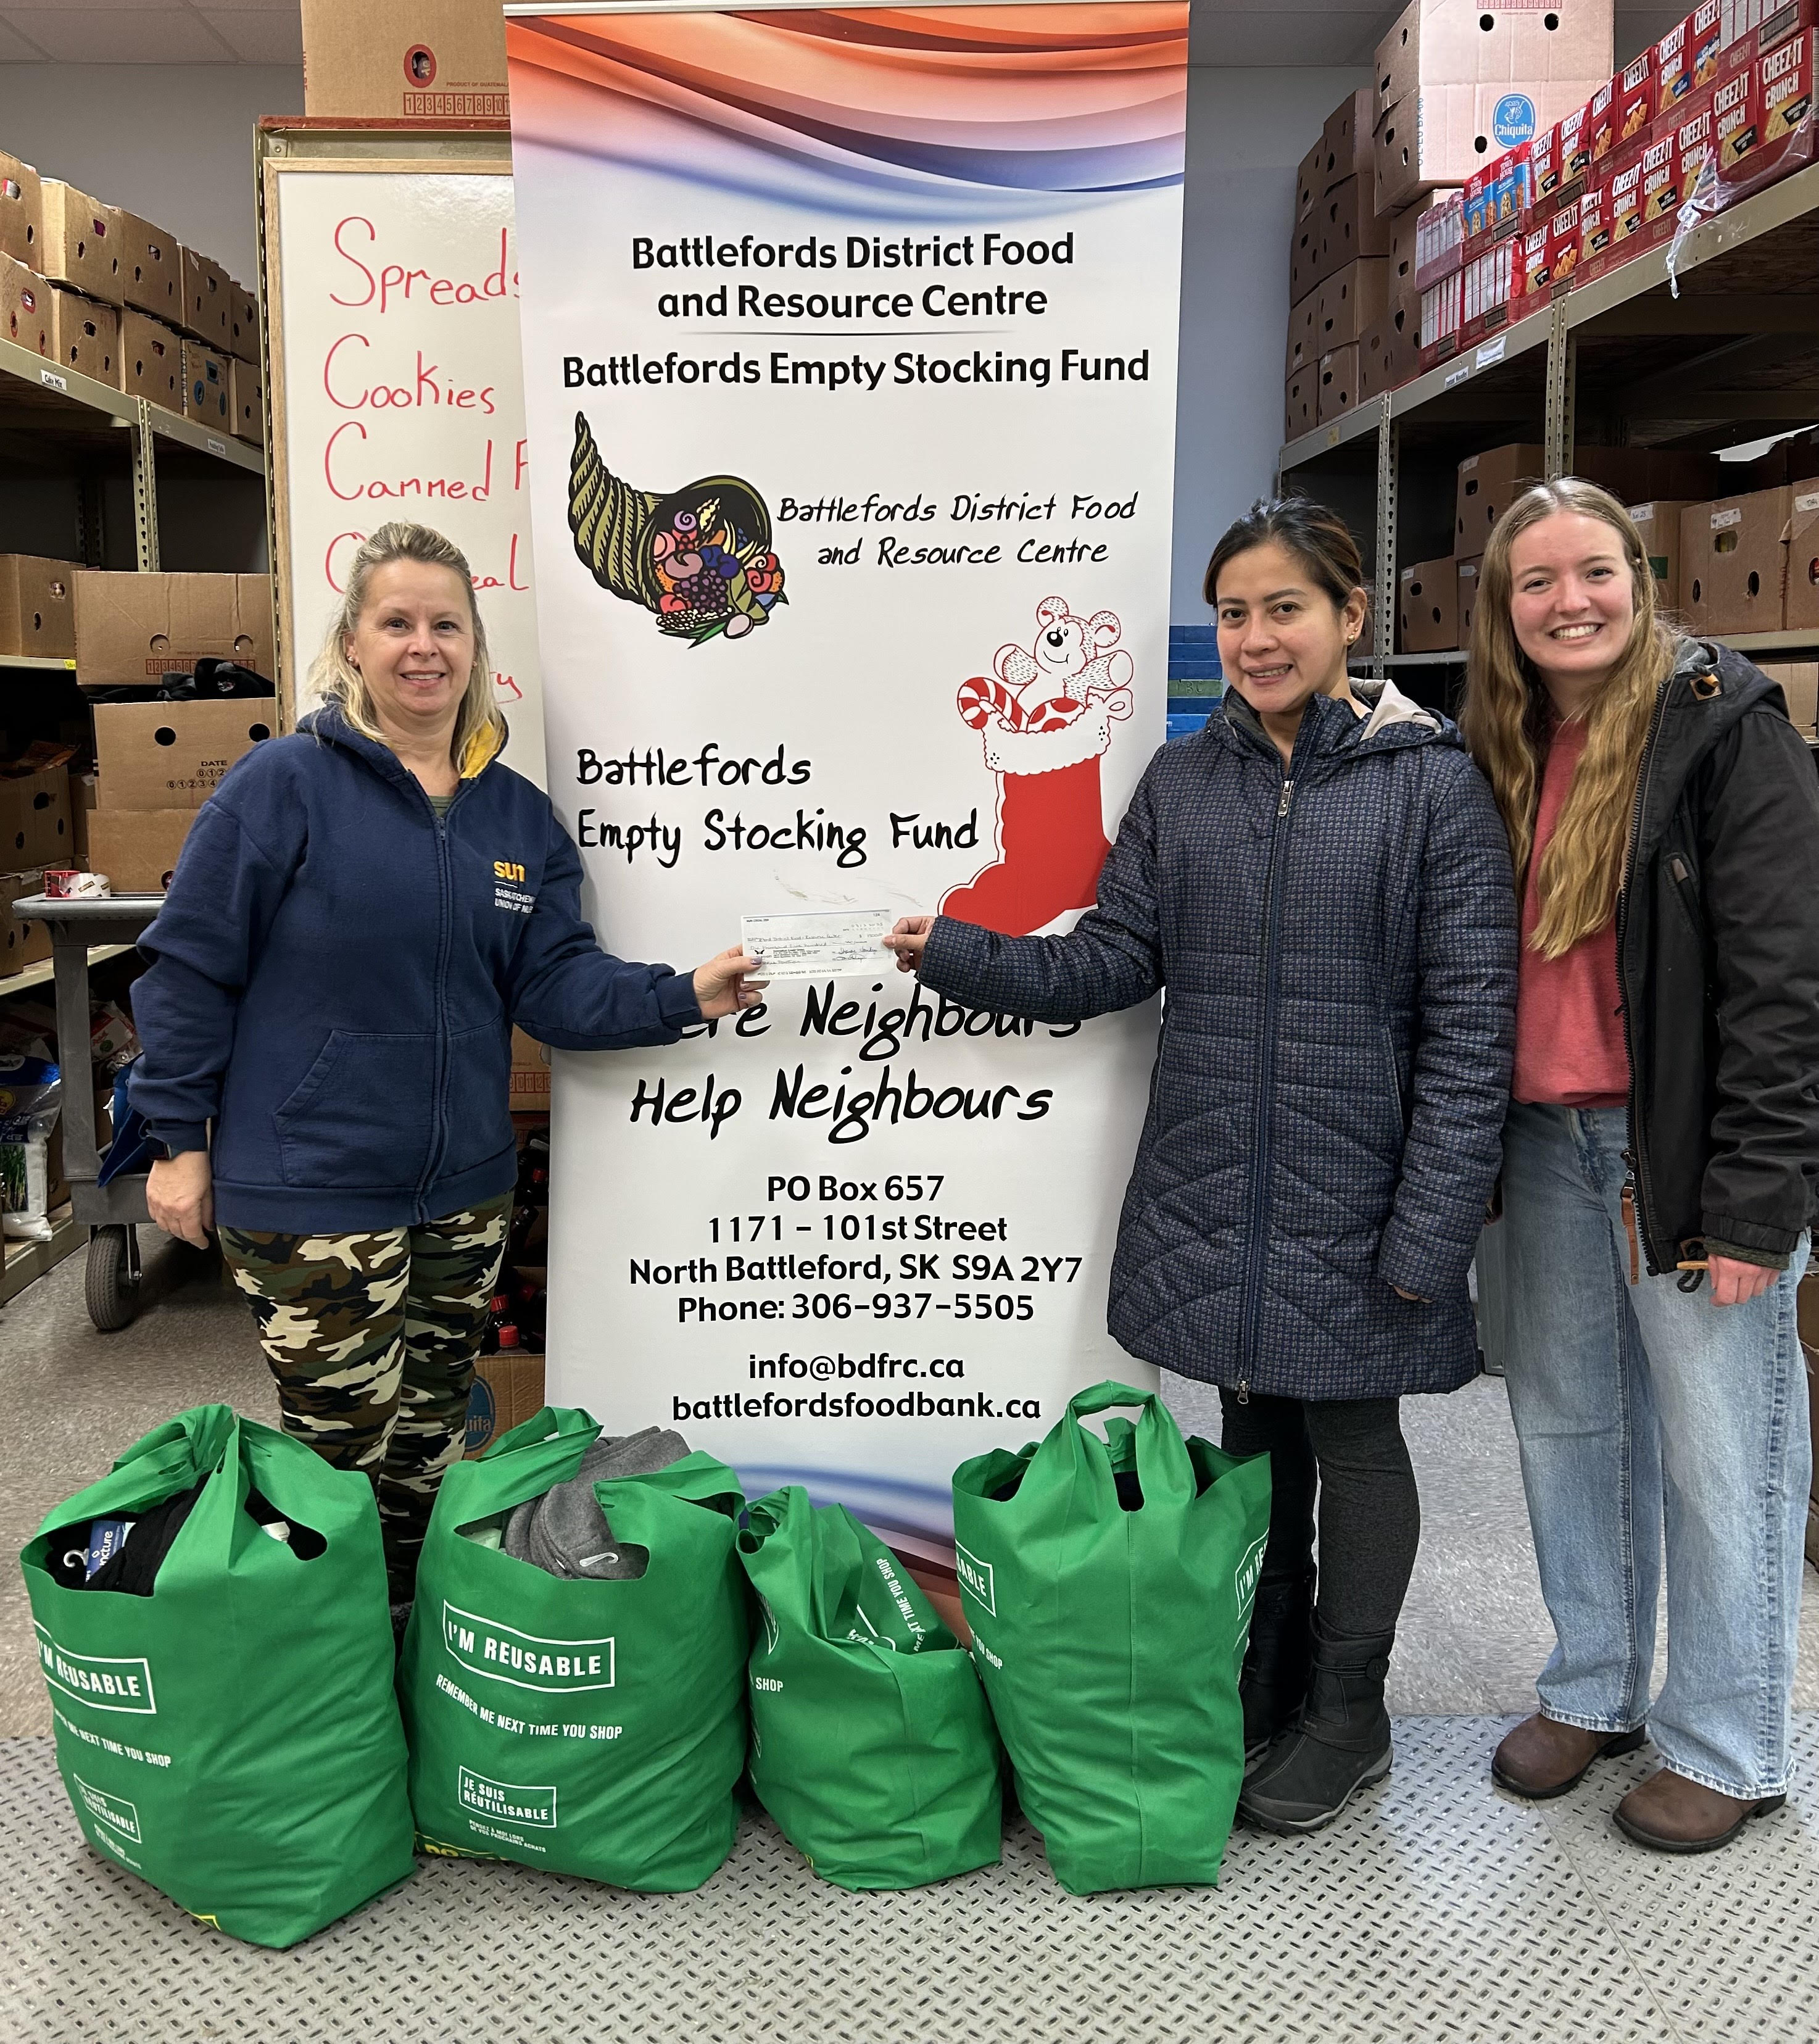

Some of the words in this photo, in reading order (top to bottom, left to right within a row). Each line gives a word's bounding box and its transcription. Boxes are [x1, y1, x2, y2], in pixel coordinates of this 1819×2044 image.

[1661, 52, 1683, 86] CRUNCH
[1762, 36, 1805, 85] CHEEZ-IT
[1714, 71, 1749, 117] CHEEZ-IT
[1765, 71, 1799, 110] CRUNCH
[1494, 123, 1533, 139] Chiquita
[1679, 110, 1711, 151] CHEEZ-IT
[1717, 104, 1746, 140] CRUNCH
[1643, 136, 1674, 174] CHEEZ-IT
[1681, 140, 1707, 174] CRUNCH
[1644, 164, 1670, 196] CRUNCH
[1614, 189, 1636, 218] CRUNCH
[632, 235, 837, 269] Battlefords
[847, 235, 974, 268] District
[984, 231, 1074, 265] Food
[658, 285, 727, 317] and
[738, 285, 913, 318] Resource
[922, 285, 1048, 317] Centre
[324, 334, 495, 413] Cookies
[563, 352, 761, 388] Battlefords
[771, 352, 887, 391] Empty
[893, 351, 1050, 388] Stocking
[1061, 349, 1149, 381] Fund
[325, 422, 492, 501] Canned
[776, 493, 937, 522] Battlefords
[950, 492, 1057, 523] District
[1071, 491, 1139, 520] Food
[818, 537, 863, 565] and
[877, 536, 1002, 568] Resource
[1017, 537, 1109, 563] Centre
[576, 742, 811, 786] Battlefords
[576, 808, 681, 868] Empty
[704, 808, 867, 868] Stocking
[889, 807, 979, 850] Fund
[629, 1073, 742, 1140] Help
[768, 1063, 1053, 1144] Neighbours
[768, 1175, 811, 1202] PO
[819, 1175, 879, 1201] Box
[885, 1175, 945, 1201] 657
[709, 1215, 781, 1244] 1171
[823, 1214, 908, 1240] 101st
[914, 1214, 1008, 1242] Street
[630, 1257, 717, 1285] North
[726, 1253, 891, 1285] Battleford,
[900, 1253, 941, 1279] SK
[952, 1254, 1014, 1281] S9A
[1021, 1256, 1083, 1283] 2Y7
[679, 1297, 784, 1323] Phone:
[792, 1293, 1034, 1321] 306-937-5505
[750, 1352, 965, 1381] info@bdfrc.ca
[673, 1391, 1042, 1421] battlefordsfoodbank.ca
[876, 1558, 895, 1580] SHOP
[887, 1579, 904, 1598] YOU
[896, 1597, 915, 1622] TIME
[449, 1621, 474, 1655] I'M
[484, 1637, 602, 1677] REUSABLE
[913, 1633, 925, 1652] ME
[985, 1648, 1003, 1670] SHOP
[56, 1655, 141, 1697] REUSABLE
[755, 1677, 784, 1692] SHOP
[436, 1674, 478, 1715] REMEMBER
[480, 1706, 495, 1725] ME
[497, 1714, 526, 1735] NEXT
[528, 1724, 559, 1737] TIME
[562, 1724, 586, 1739] YOU
[589, 1726, 623, 1740] SHOP
[79, 1729, 100, 1747] NEXT
[101, 1737, 124, 1756] TIME
[124, 1746, 144, 1762] YOU
[145, 1751, 172, 1768] SHOP
[463, 1777, 474, 1790] JE
[478, 1783, 505, 1801] SUIS
[463, 1789, 548, 1820] RÉUTILISABLE
